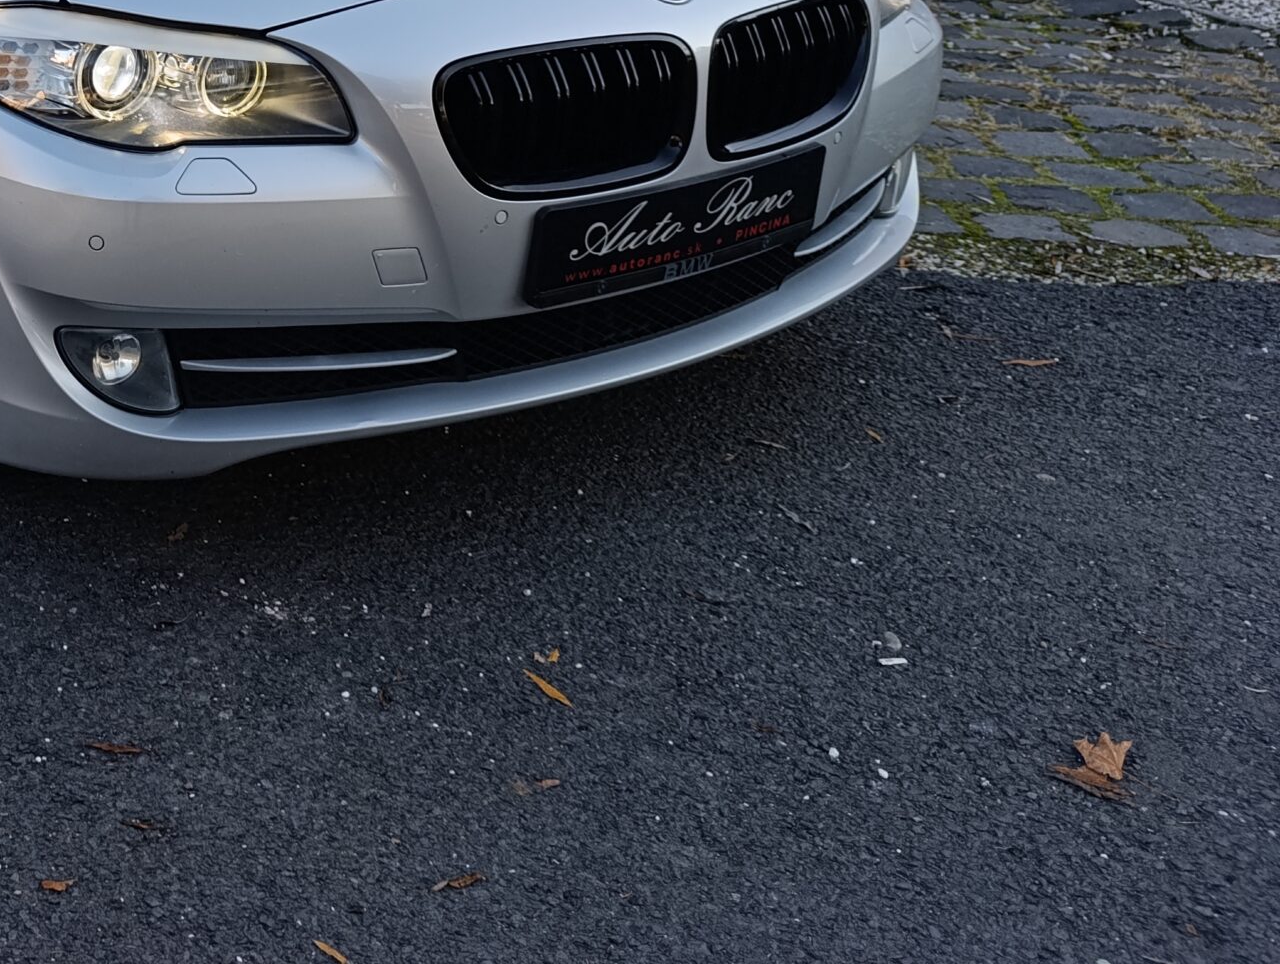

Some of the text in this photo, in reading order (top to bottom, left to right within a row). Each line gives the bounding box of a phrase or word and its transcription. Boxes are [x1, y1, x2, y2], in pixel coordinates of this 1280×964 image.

[564, 214, 791, 283] www.autoranc.sk PINCINA
[569, 175, 795, 261] Auto Ranc
[663, 251, 715, 281] BMW
